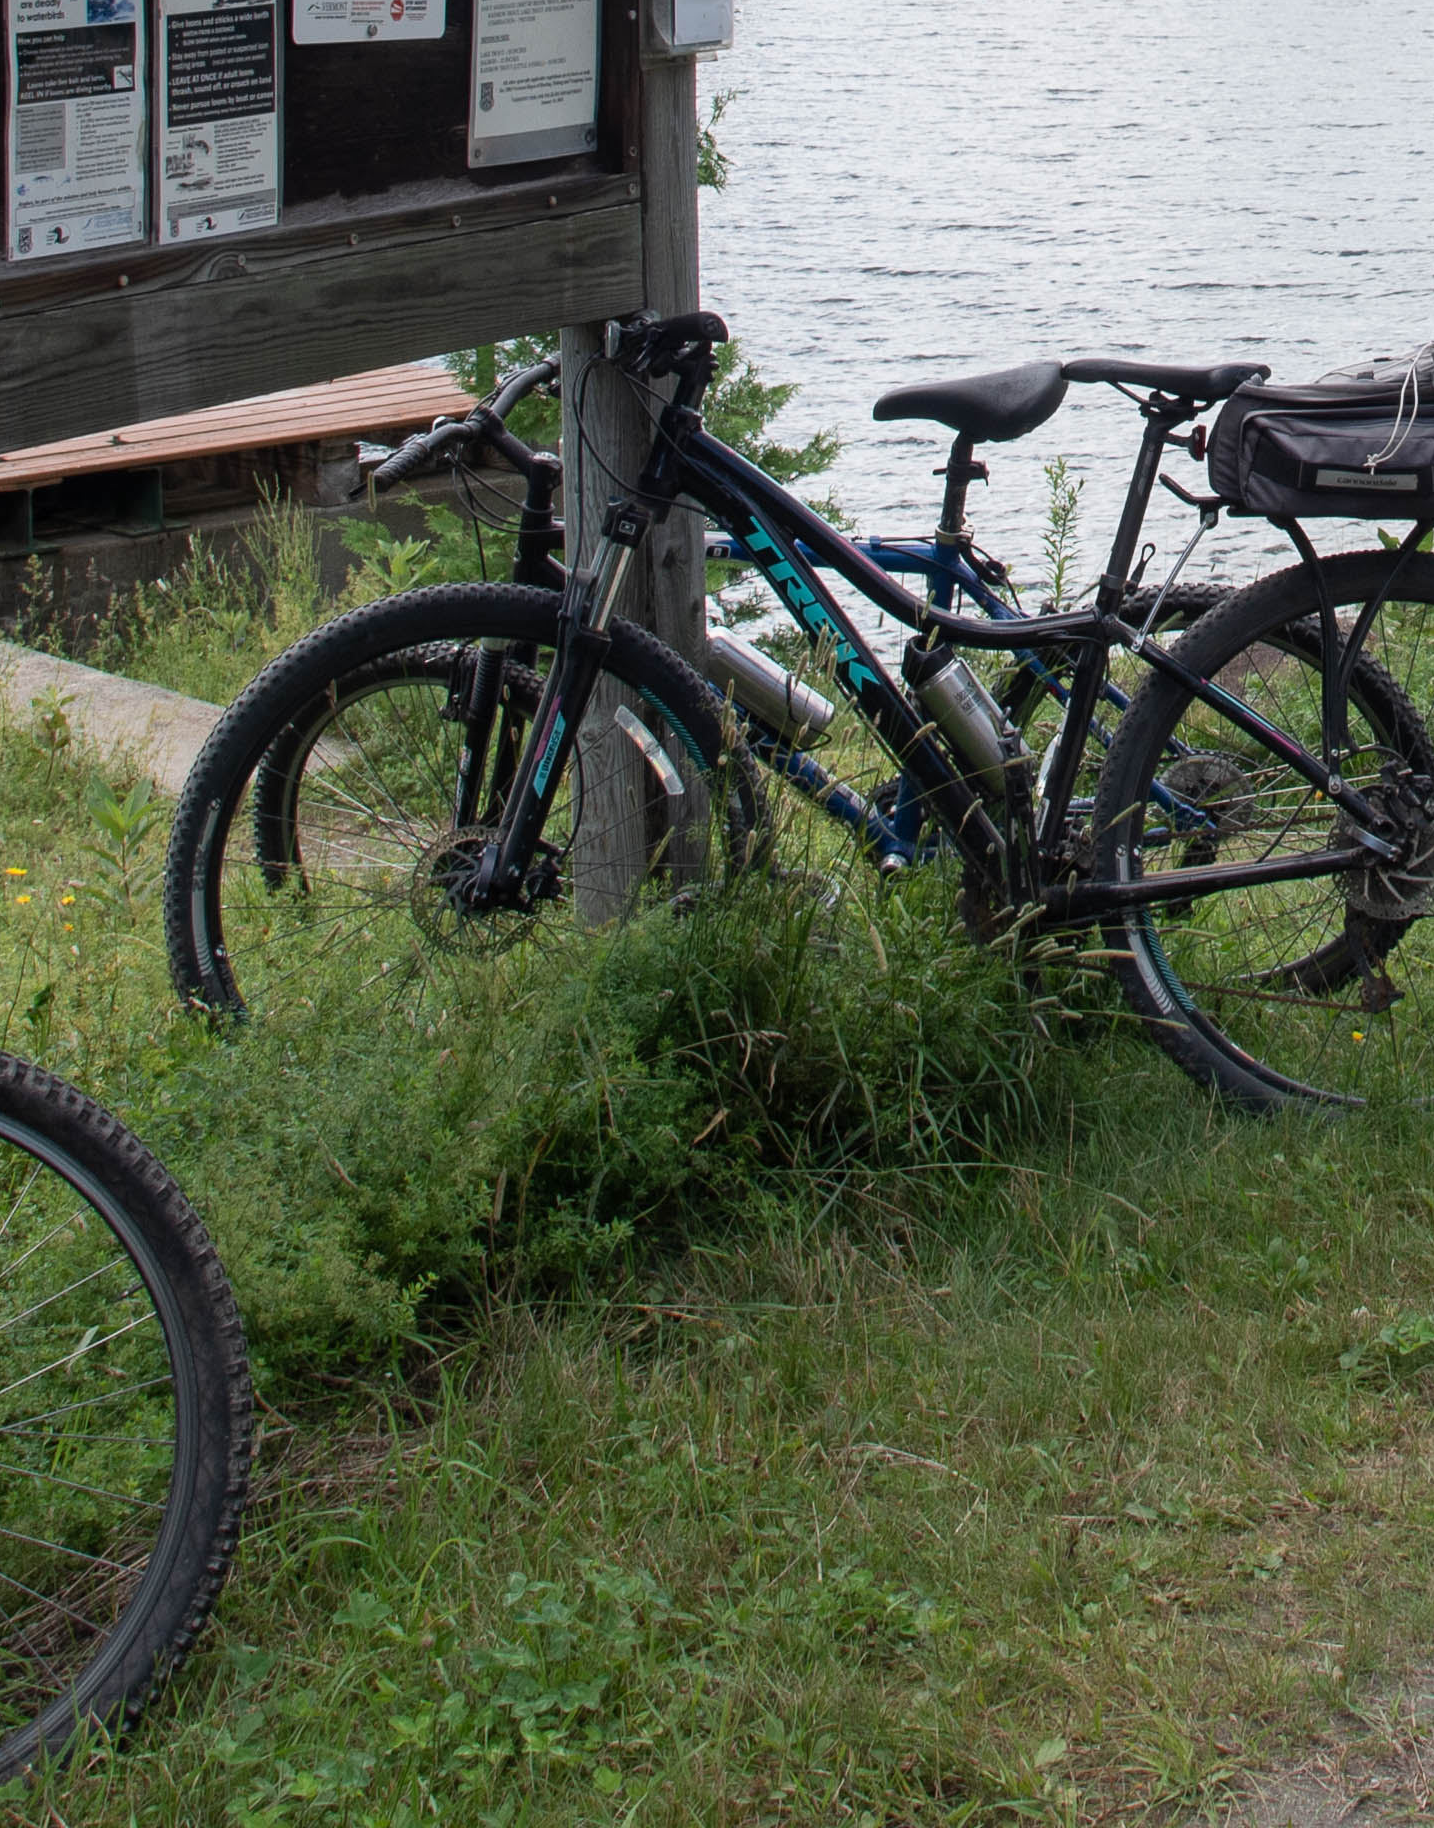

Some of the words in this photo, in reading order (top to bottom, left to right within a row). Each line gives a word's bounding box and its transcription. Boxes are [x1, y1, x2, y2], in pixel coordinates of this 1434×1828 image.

[21, 0, 33, 9] are
[17, 13, 24, 23] to
[27, 11, 64, 22] waterbirds
[743, 515, 881, 692] TREK
